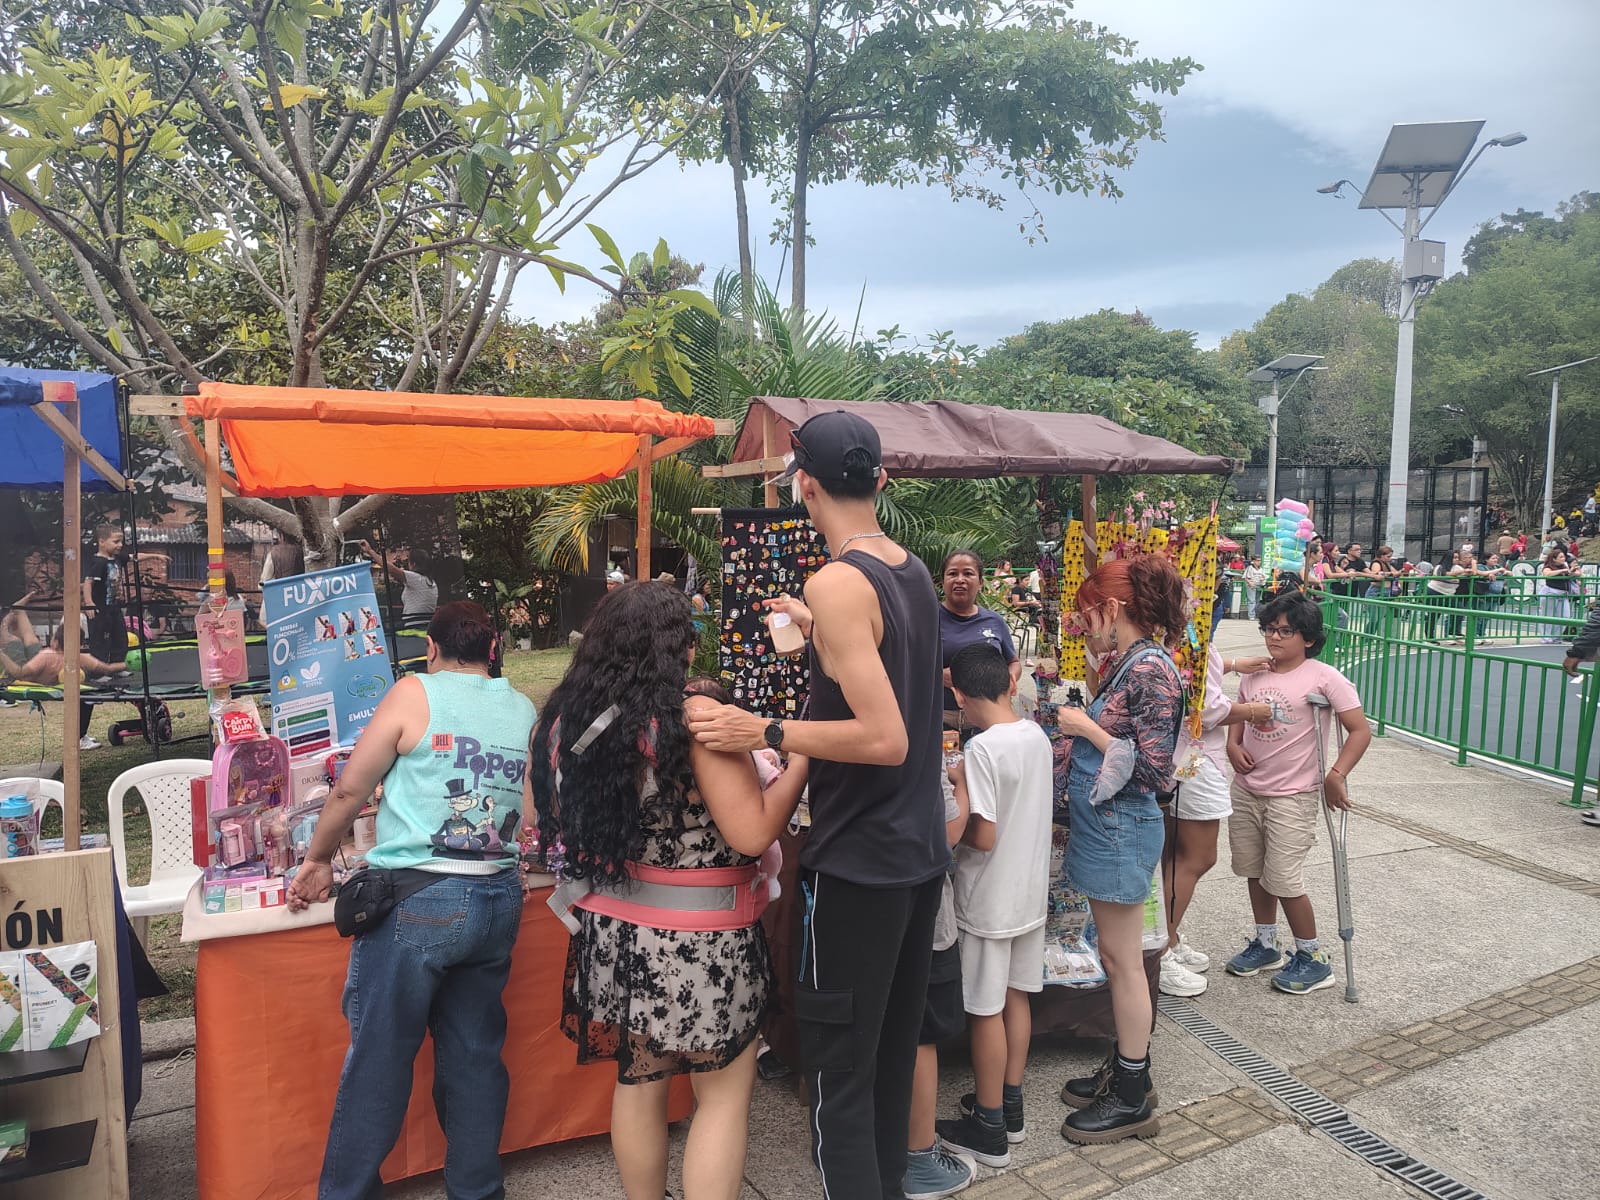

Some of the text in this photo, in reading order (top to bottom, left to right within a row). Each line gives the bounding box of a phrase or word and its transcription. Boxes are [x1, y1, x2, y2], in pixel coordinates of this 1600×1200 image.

[283, 573, 358, 607] FUXION
[435, 734, 449, 746] DELL
[454, 736, 526, 789] Popey
[0, 899, 63, 949] ÓN
